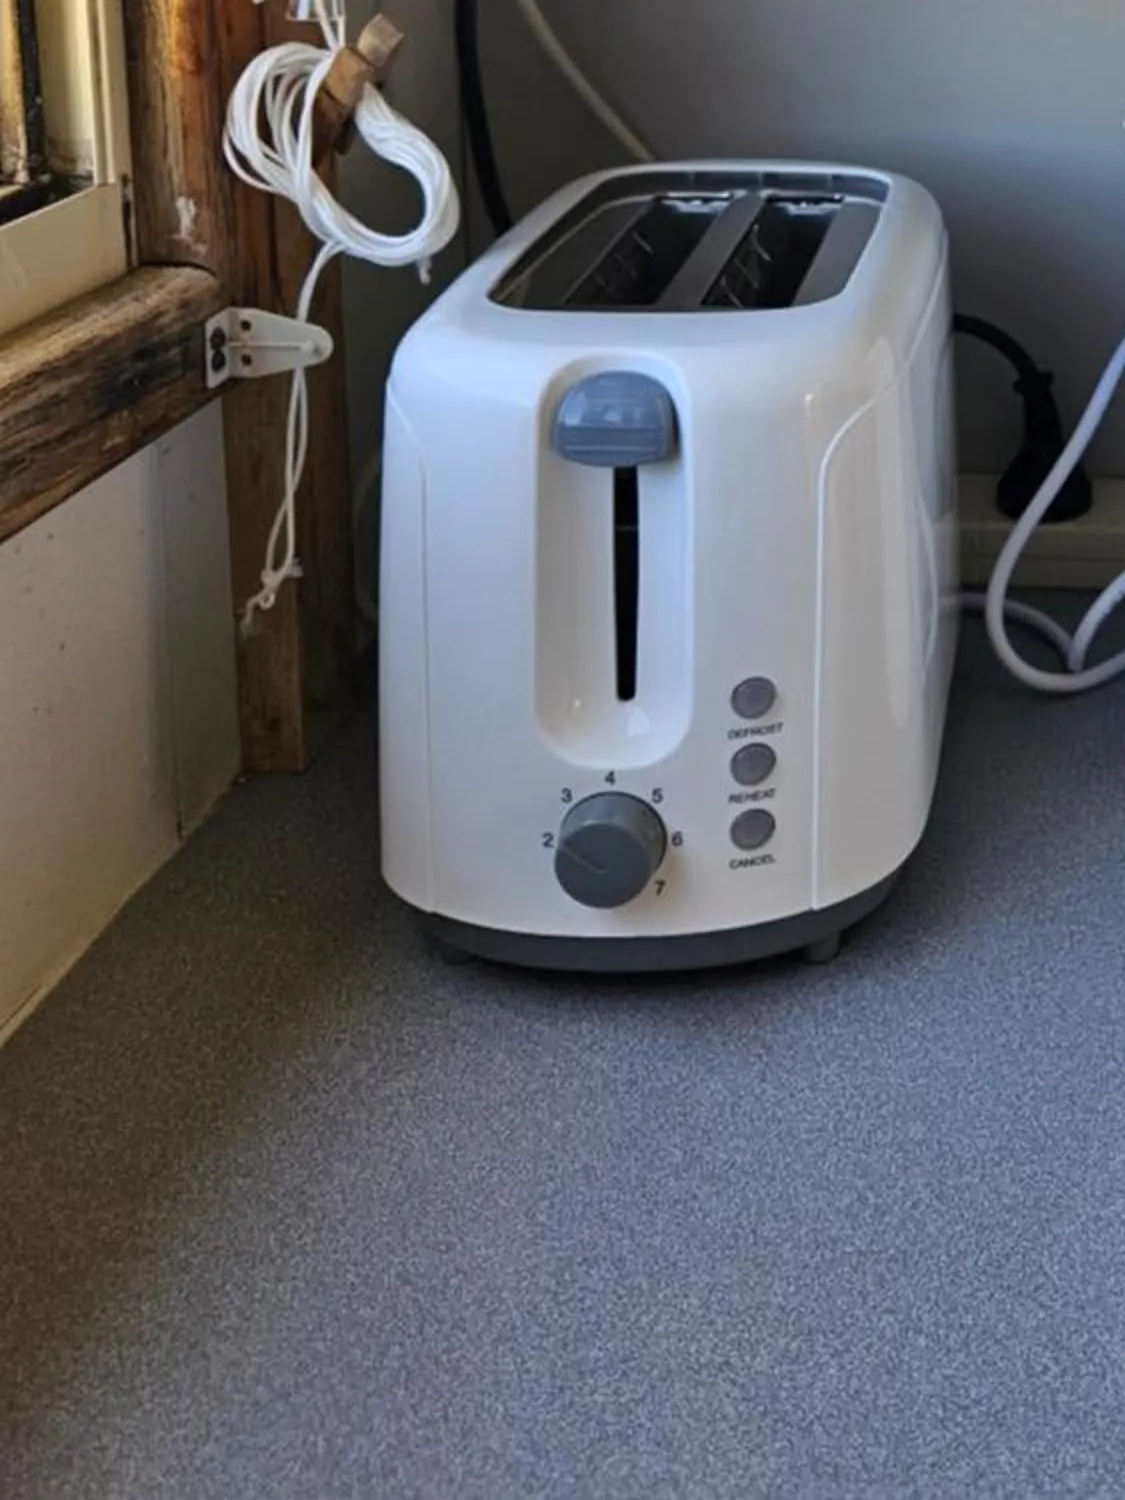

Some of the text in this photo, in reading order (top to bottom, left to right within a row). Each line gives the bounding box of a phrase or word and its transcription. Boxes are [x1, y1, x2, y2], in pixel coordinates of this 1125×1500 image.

[727, 721, 784, 740] DEFROST
[604, 770, 616, 786] 4
[560, 786, 574, 805] 3
[651, 786, 665, 804] 5
[727, 783, 777, 804] REHEAT
[541, 830, 556, 849] 2
[670, 829, 685, 847] 6
[728, 853, 776, 870] CANCEL
[654, 879, 666, 896] 7
